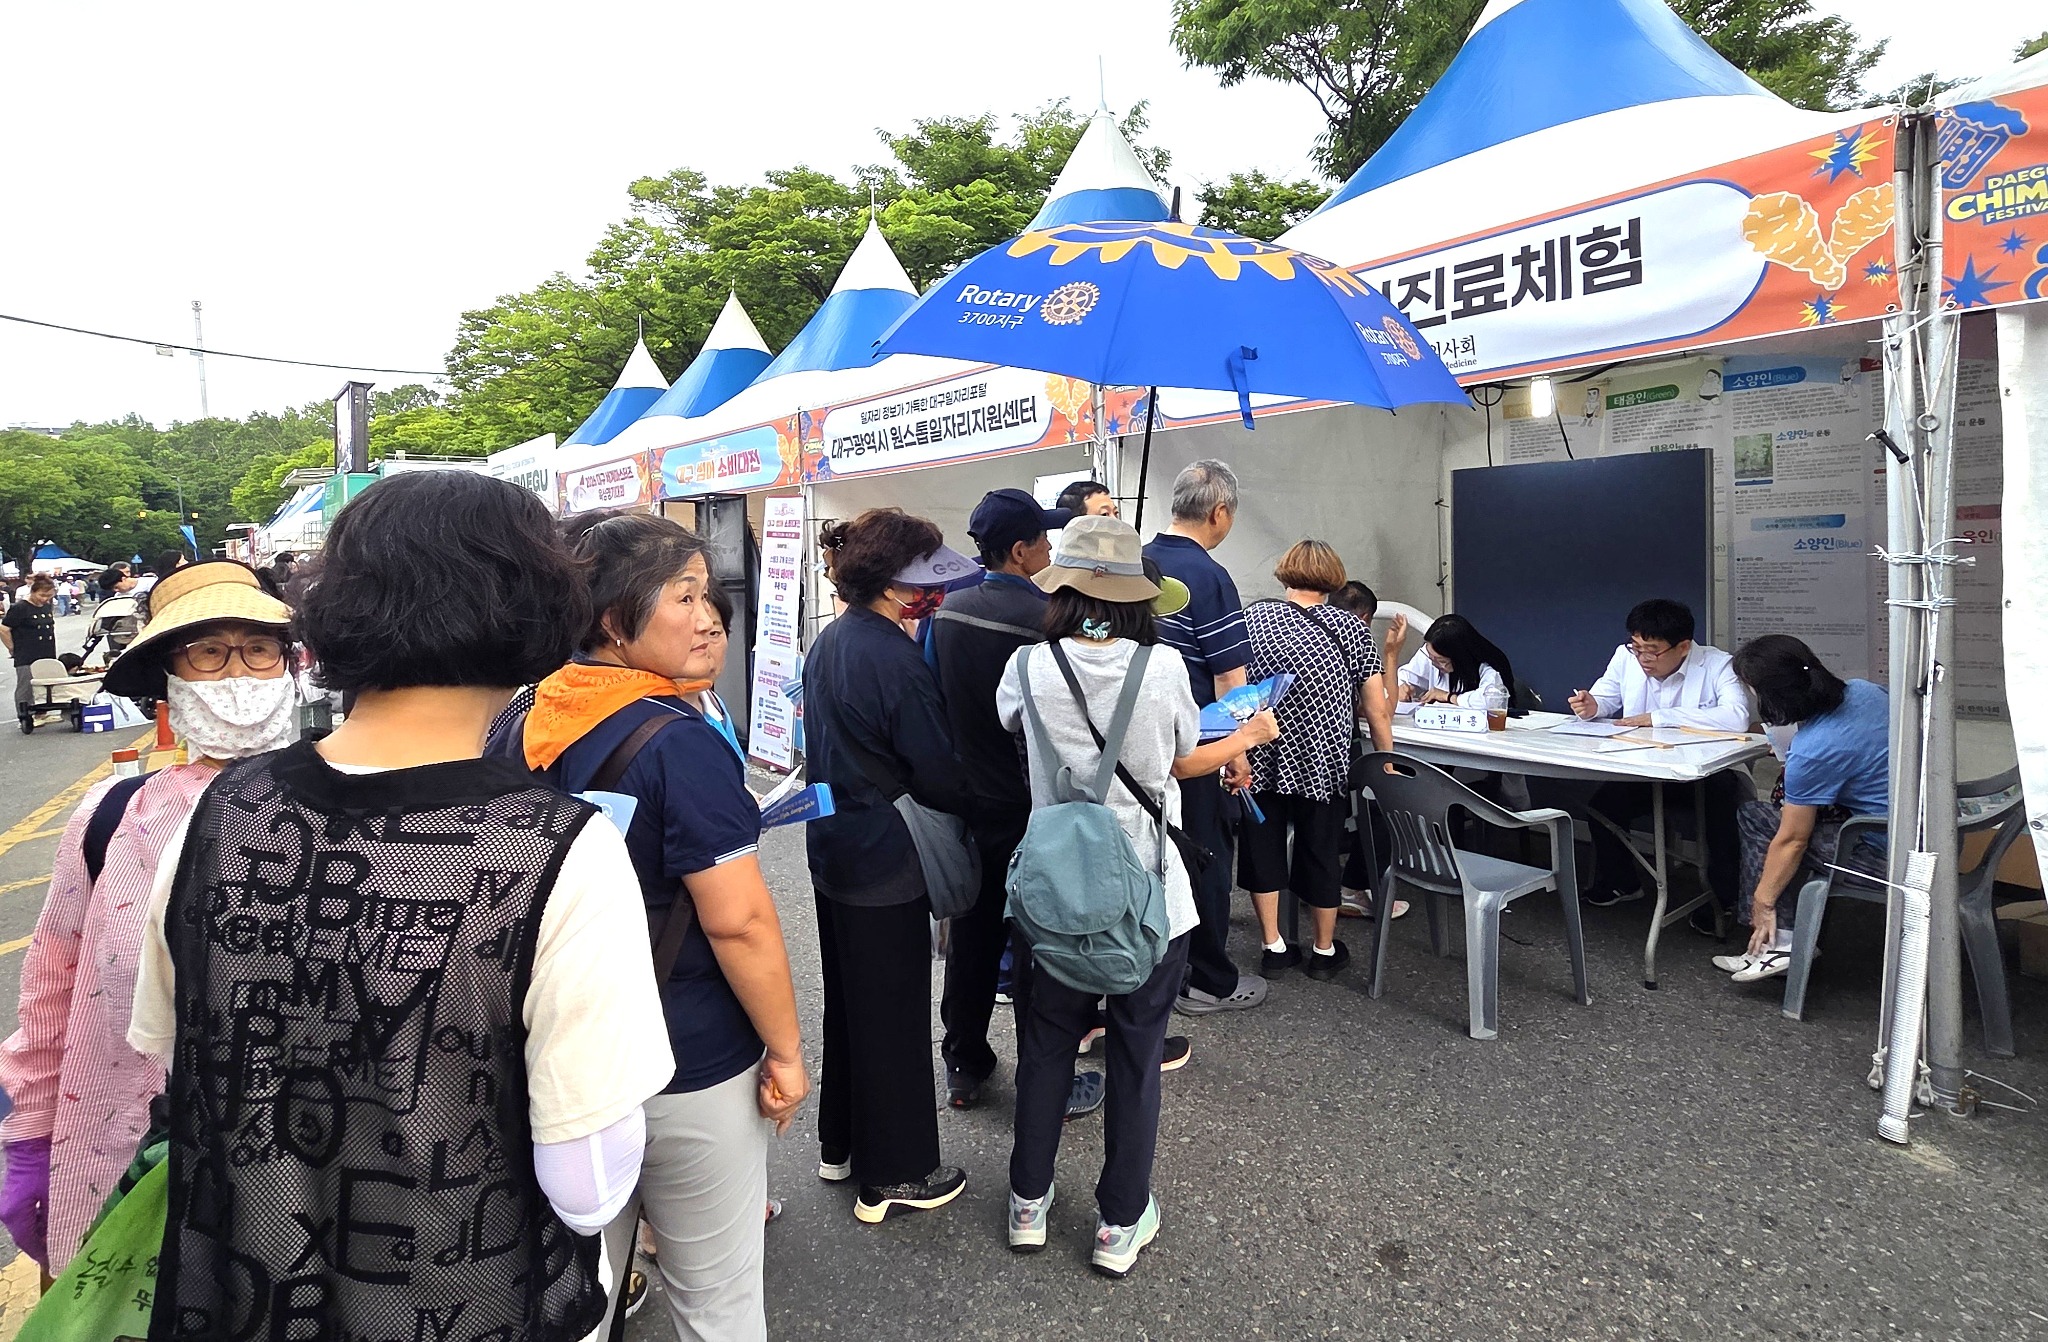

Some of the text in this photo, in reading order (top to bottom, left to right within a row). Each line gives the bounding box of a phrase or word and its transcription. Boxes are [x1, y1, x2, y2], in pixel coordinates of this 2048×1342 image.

[1988, 166, 2048, 190] DAEG
[1382, 217, 1643, 329] 진료체험
[956, 284, 1042, 313] Rotary
[958, 311, 1025, 330] 3700지구
[860, 382, 989, 425] 일자리 정보가 가득한 대구일자리포털
[831, 395, 1038, 460] 대구광역시 원스톱일자리지원센터
[717, 448, 761, 478] 소비대전
[1794, 537, 1863, 551] 소양인(Blue)
